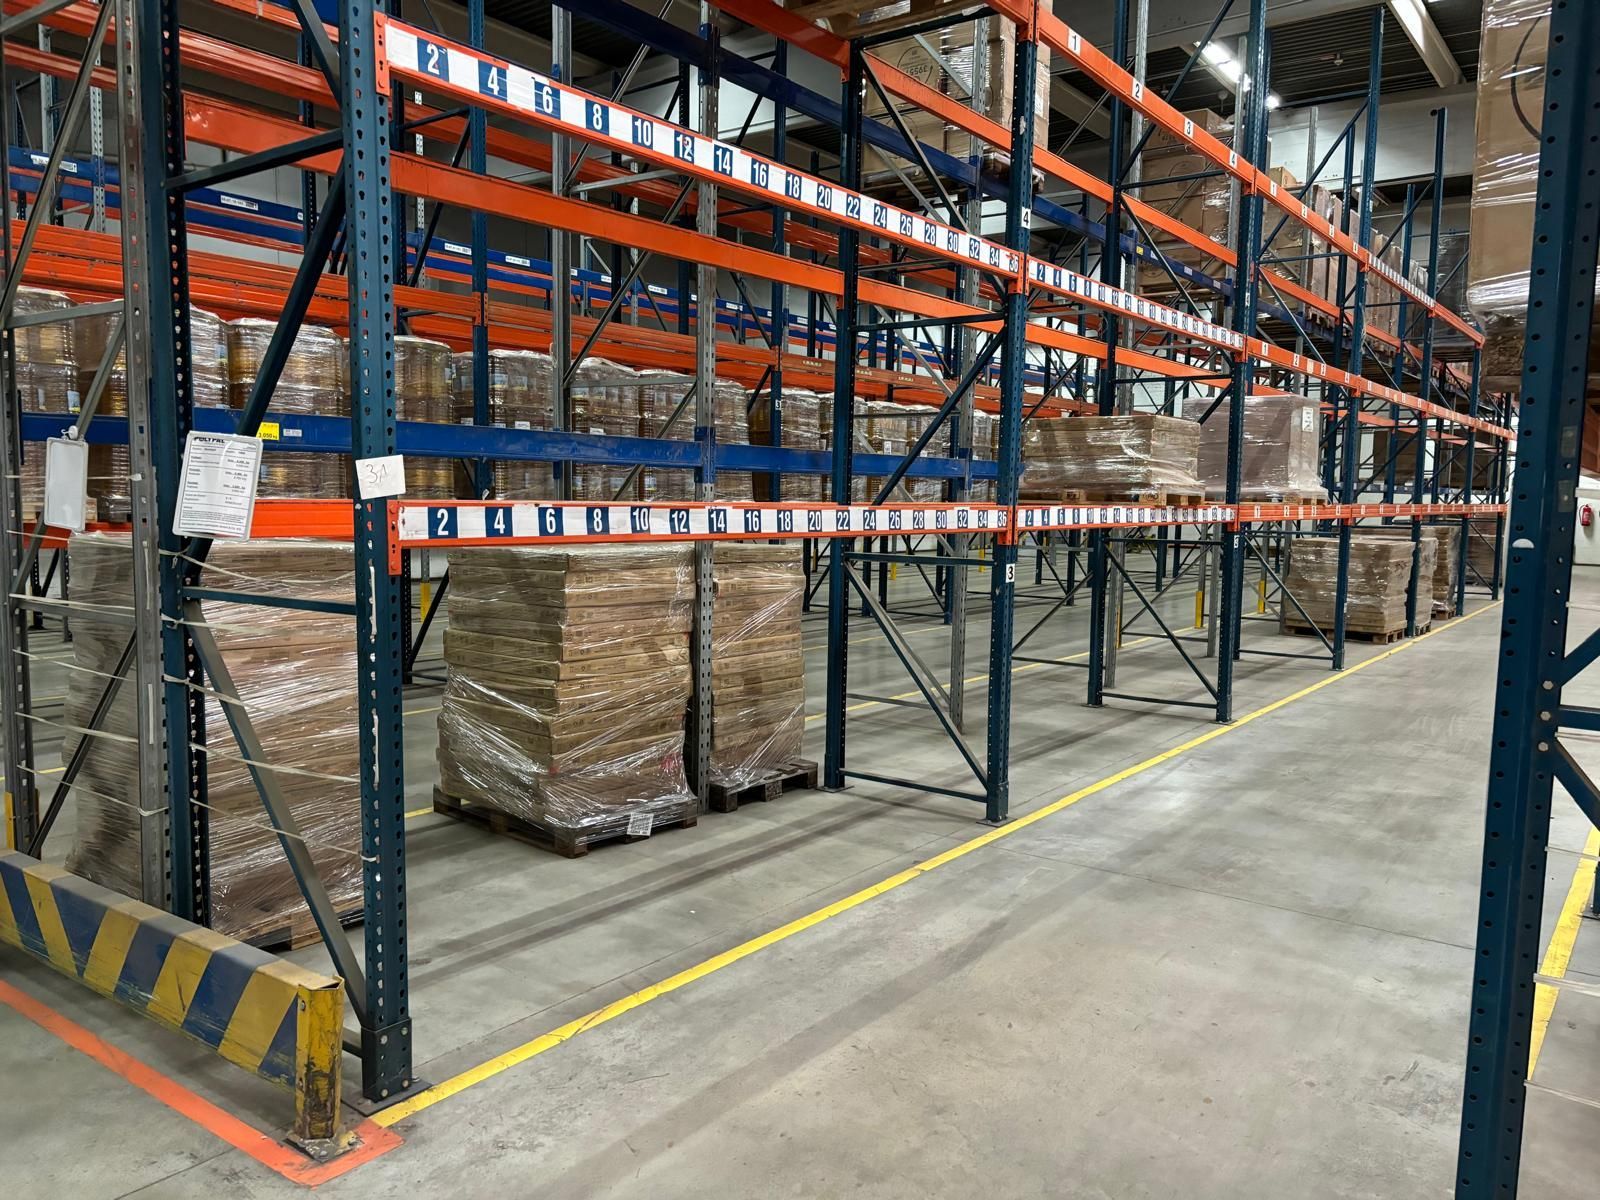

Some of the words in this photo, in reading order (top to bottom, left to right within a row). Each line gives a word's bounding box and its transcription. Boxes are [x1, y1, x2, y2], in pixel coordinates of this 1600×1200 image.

[1134, 83, 1140, 99] 2
[1186, 121, 1192, 135] 3
[1231, 154, 1236, 166] 4
[426, 43, 440, 75] 2
[487, 66, 499, 96] 4
[542, 86, 554, 114] 6
[592, 103, 603, 131] 8
[634, 118, 652, 147] 10
[676, 133, 693, 162] 12
[716, 148, 731, 176] 14
[753, 164, 767, 187] 16
[788, 174, 800, 198] 18
[818, 186, 832, 210] 20
[847, 196, 860, 218] 22
[874, 206, 887, 227] 24
[900, 216, 912, 236] 26
[925, 224, 936, 244] 28
[948, 233, 958, 253] 30
[970, 240, 980, 259] 32
[990, 248, 1000, 266] 34
[1009, 255, 1018, 273] 36
[1024, 211, 1029, 226] 4
[1038, 266, 1044, 280] 2
[1054, 272, 1060, 285] 4
[1070, 277, 1076, 290] 6
[437, 508, 449, 536] 2
[494, 508, 505, 534] 4
[546, 508, 556, 534] 6
[593, 508, 602, 532] 8
[632, 508, 648, 531] 10
[671, 510, 687, 533] 12
[710, 511, 726, 532] 14
[746, 511, 759, 532] 16
[778, 510, 791, 530] 18
[808, 510, 822, 530] 20
[837, 510, 850, 530] 22
[864, 510, 876, 530] 24
[889, 510, 900, 528] 26
[913, 510, 924, 528] 28
[936, 510, 946, 528] 30
[958, 510, 968, 527] 32
[978, 510, 988, 527] 34
[998, 510, 1006, 527] 36
[1027, 509, 1032, 525] 2
[1043, 509, 1048, 524] 4
[1060, 509, 1064, 524] 6
[1074, 509, 1078, 524] 8
[1101, 508, 1107, 523] 12
[1114, 508, 1120, 522] 14
[1008, 566, 1014, 580] 3
